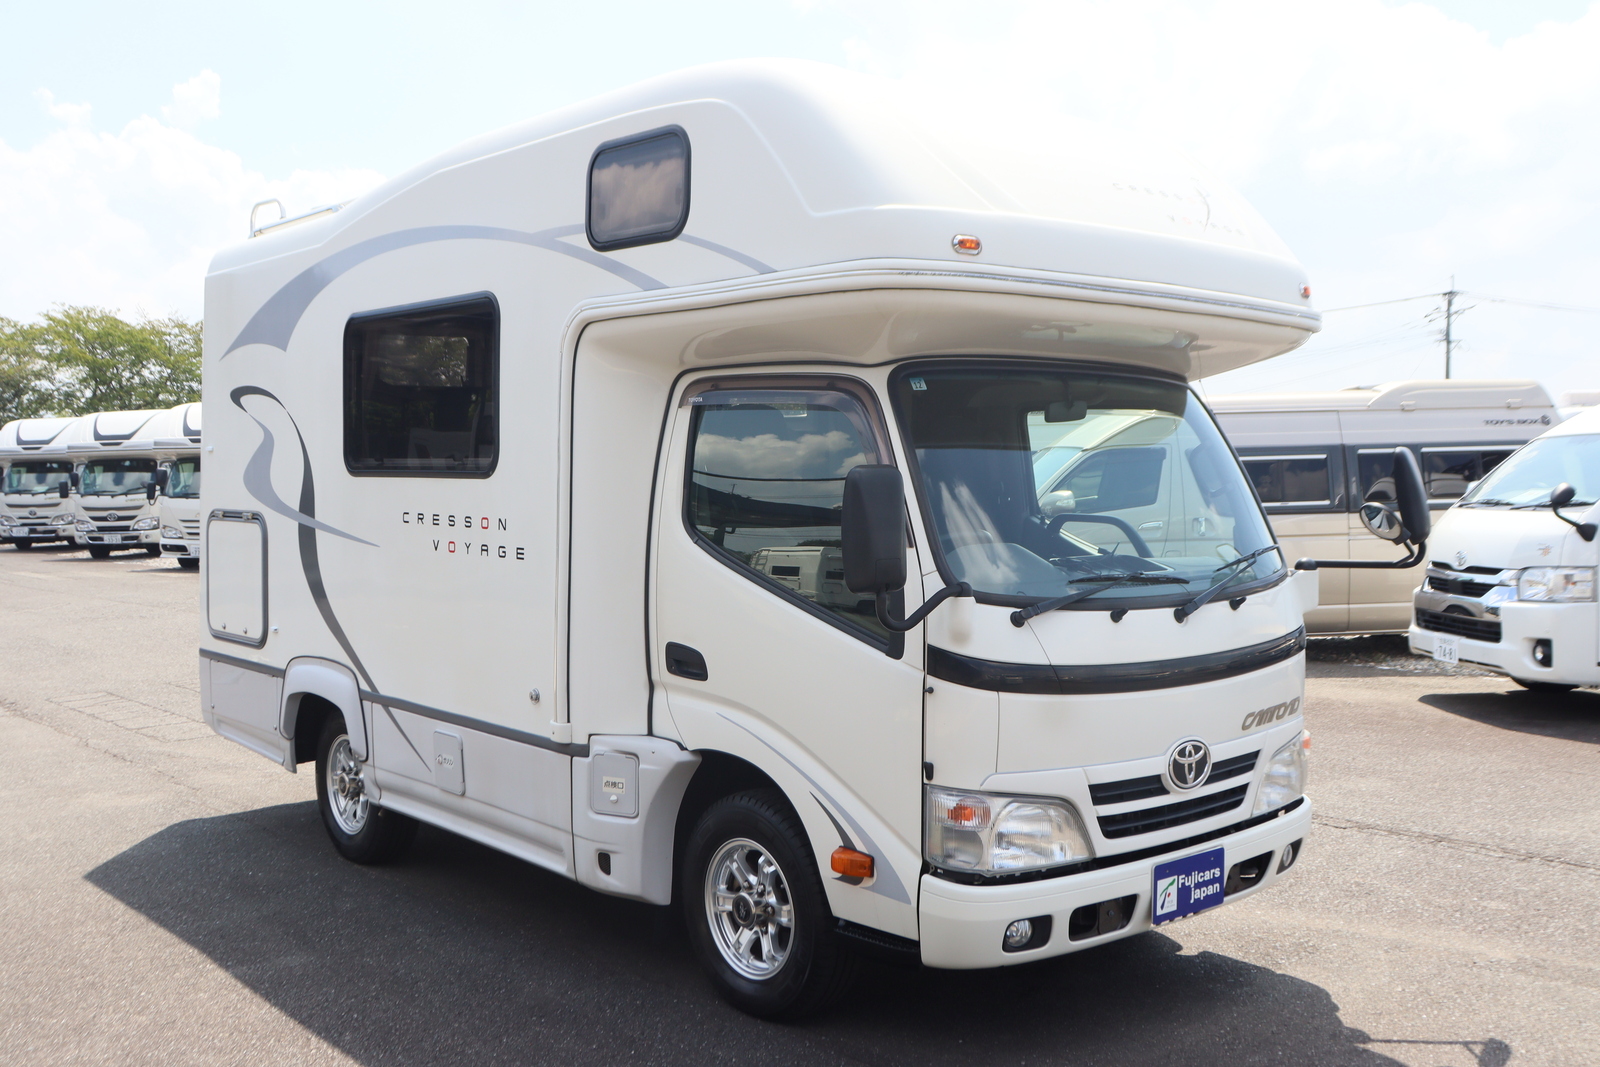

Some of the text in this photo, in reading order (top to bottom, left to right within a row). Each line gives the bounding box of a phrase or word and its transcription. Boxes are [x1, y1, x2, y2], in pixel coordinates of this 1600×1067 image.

[913, 381, 923, 389] 12
[402, 511, 507, 531] CRESSON
[433, 539, 525, 560] VOYAGE
[604, 780, 624, 790] 点検口
[1178, 867, 1221, 888] Fujicars
[1190, 883, 1220, 904] japan
